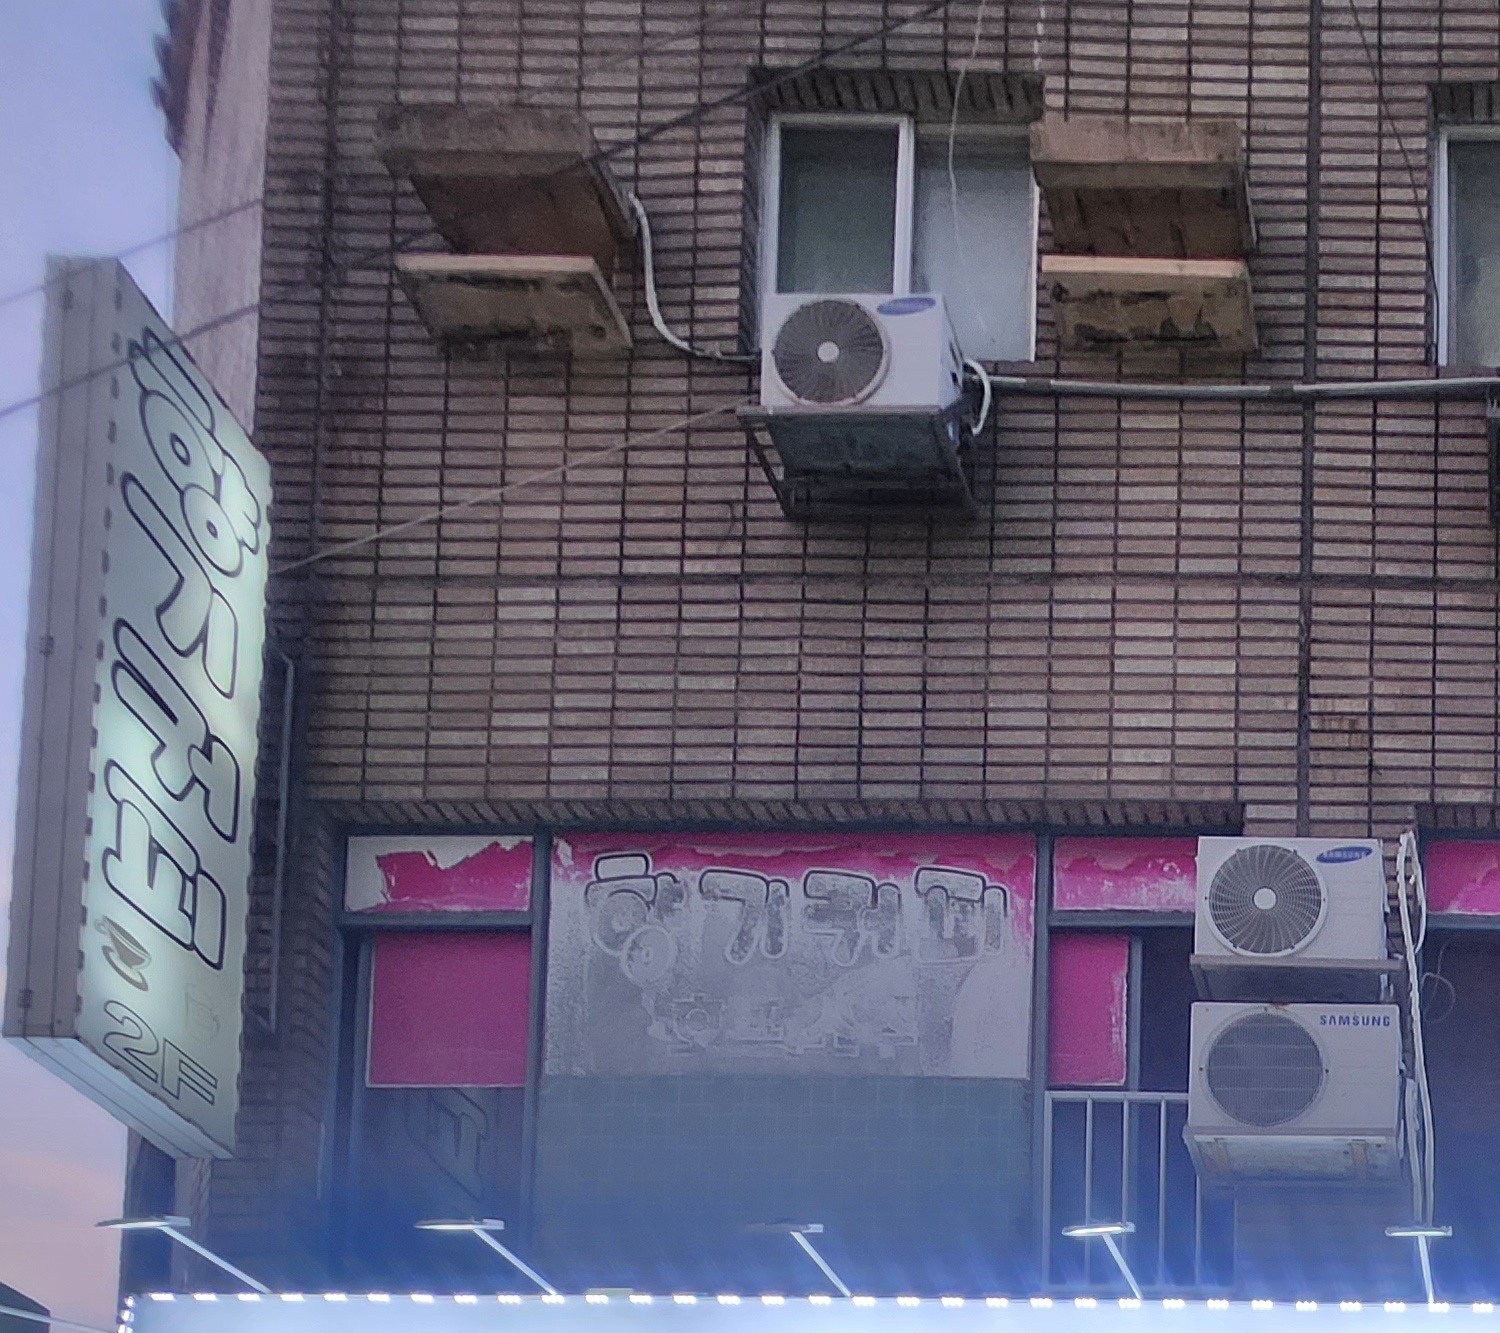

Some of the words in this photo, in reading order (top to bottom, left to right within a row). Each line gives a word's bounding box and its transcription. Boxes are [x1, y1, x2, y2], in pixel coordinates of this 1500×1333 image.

[103, 327, 261, 970] 향기커피
[102, 998, 220, 1107] 2F
[1319, 1014, 1391, 1028] SAMSUNG
